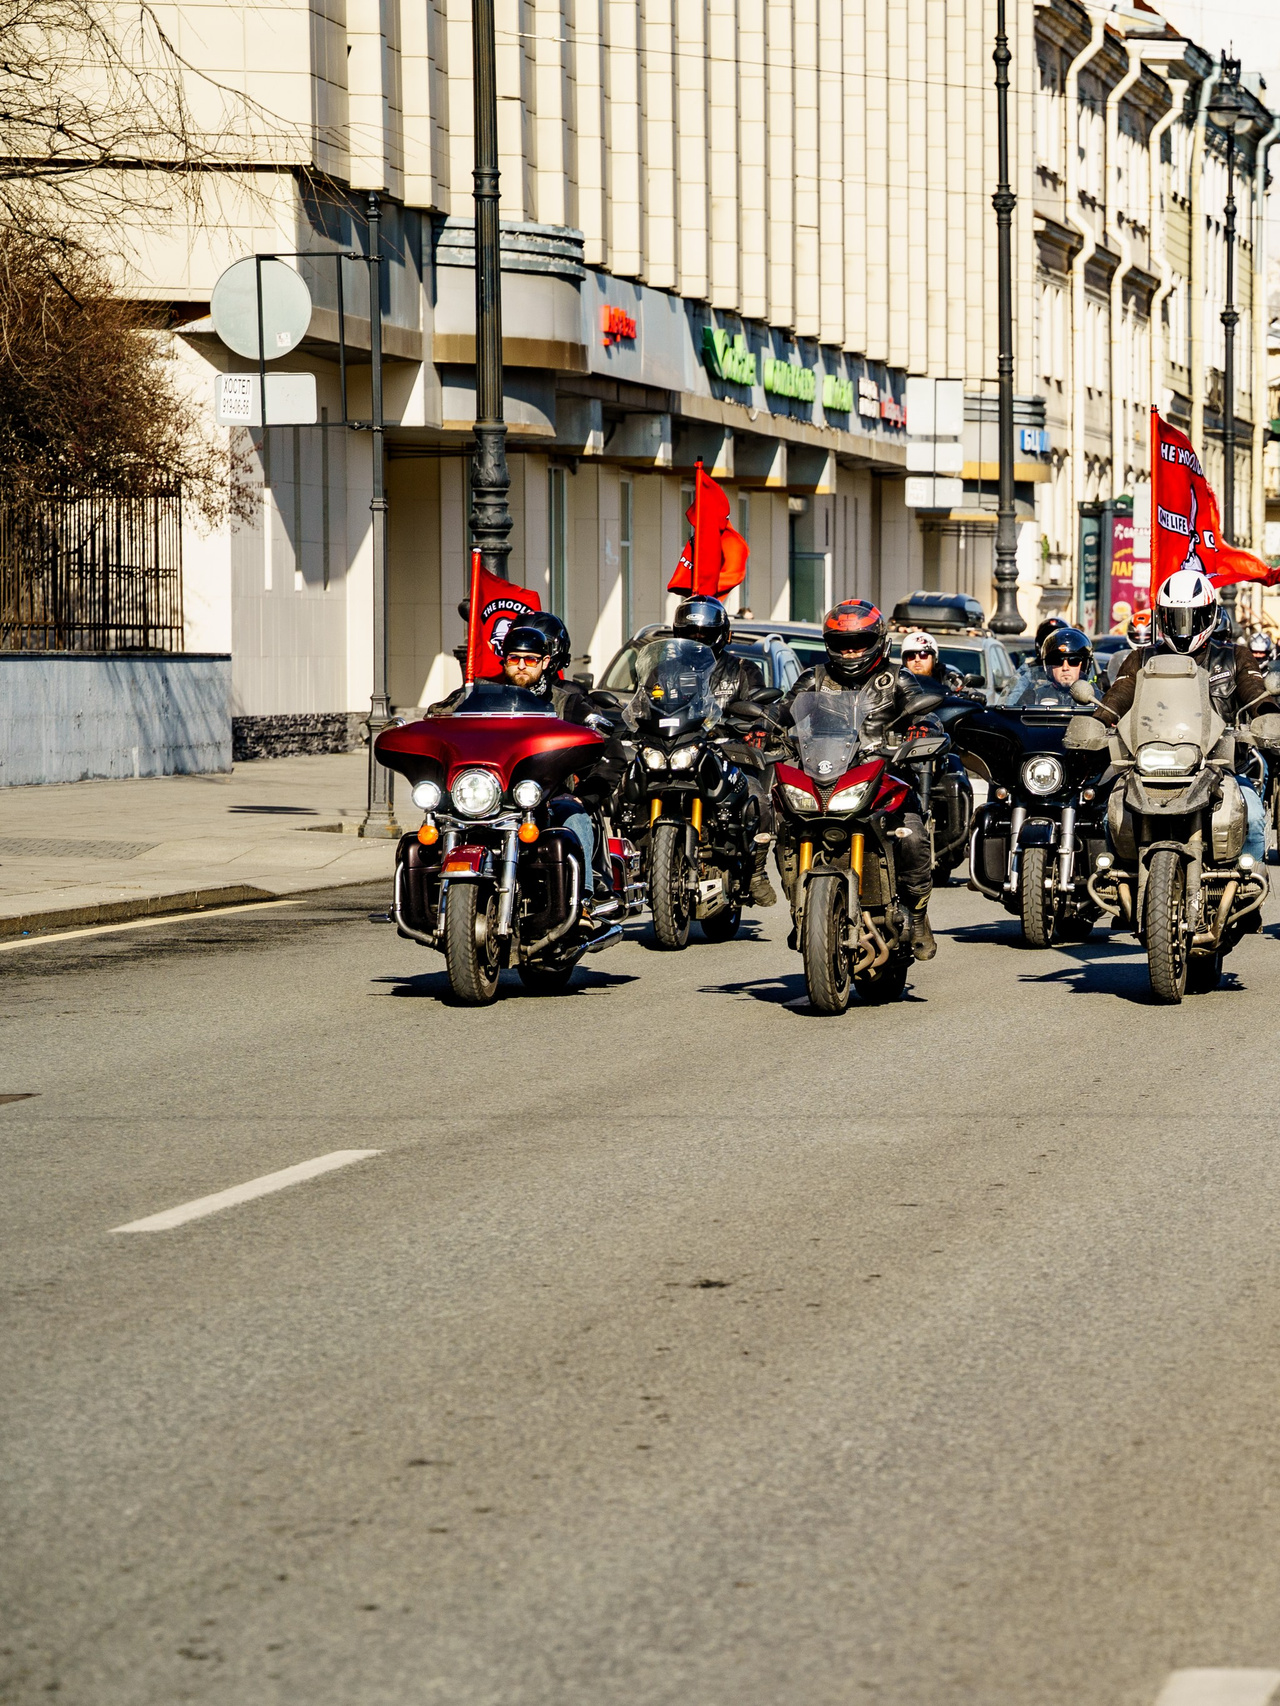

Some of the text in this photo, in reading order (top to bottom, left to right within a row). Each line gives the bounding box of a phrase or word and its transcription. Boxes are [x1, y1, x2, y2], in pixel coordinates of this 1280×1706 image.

[223, 378, 251, 395] ХОСТЕЛ
[1160, 442, 1176, 462] HE
[1160, 509, 1170, 527] ONE
[1170, 515, 1188, 532] LIFE
[680, 556, 694, 570] PET
[483, 601, 497, 618] THE
